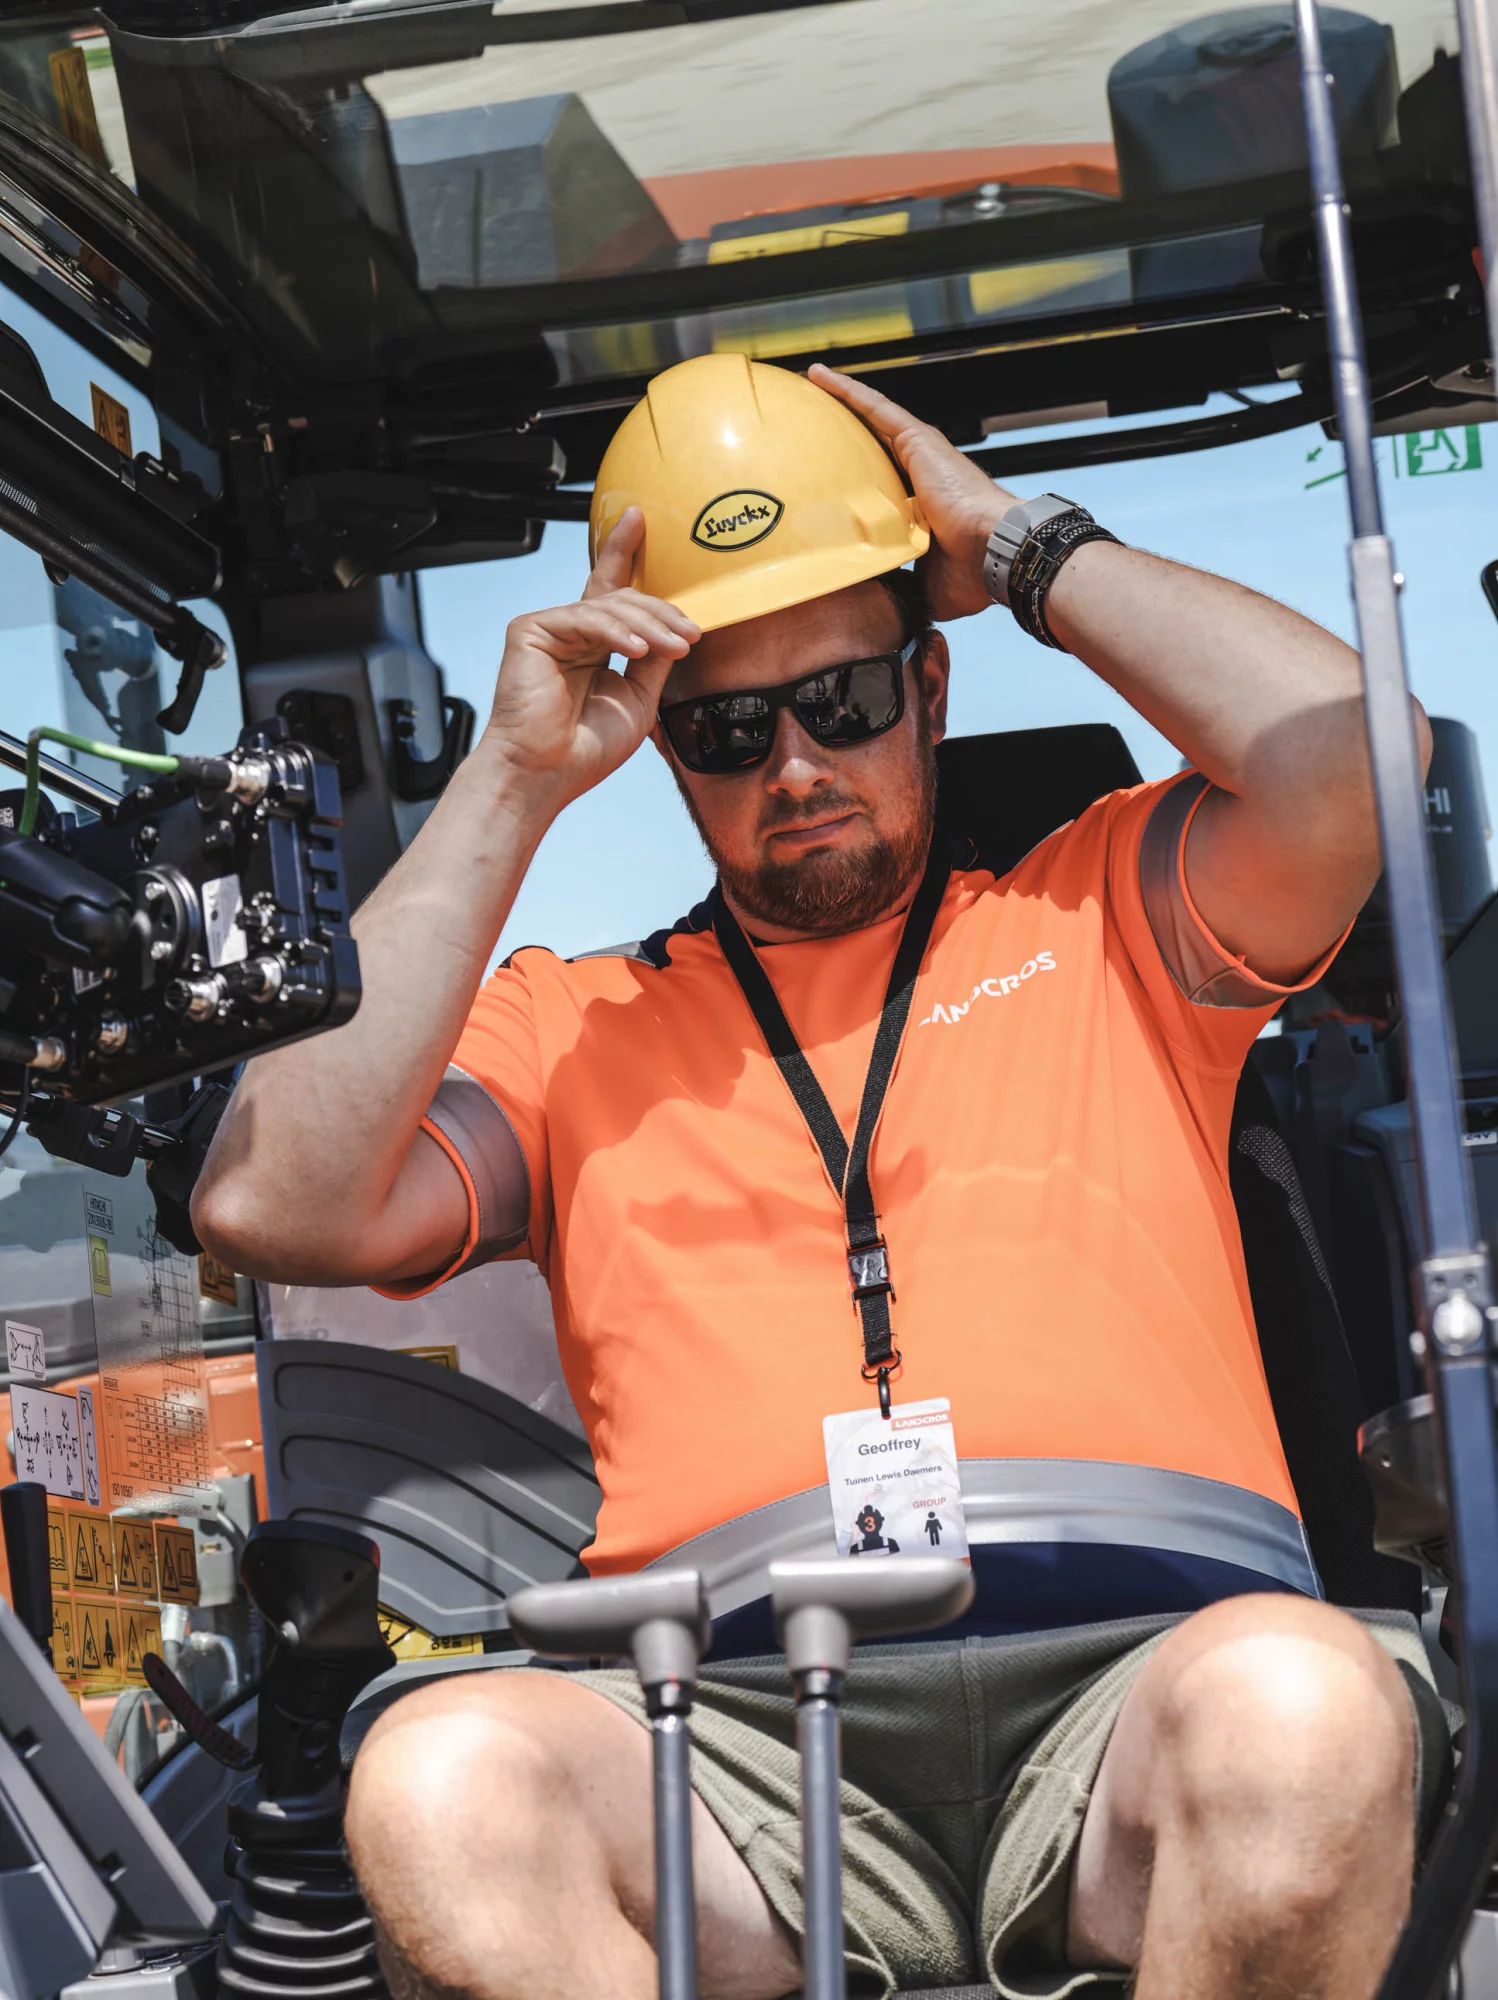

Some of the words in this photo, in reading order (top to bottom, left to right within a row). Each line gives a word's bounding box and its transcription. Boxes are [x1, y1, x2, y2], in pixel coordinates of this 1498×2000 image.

[704, 504, 771, 539] Luyckx
[858, 1437, 922, 1456] Geoffrey
[845, 1476, 875, 1487] Tuinen
[876, 1470, 902, 1482] Lewis
[903, 1465, 943, 1477] Daemers
[912, 1497, 948, 1510] GROUP
[863, 1515, 877, 1533] 3
